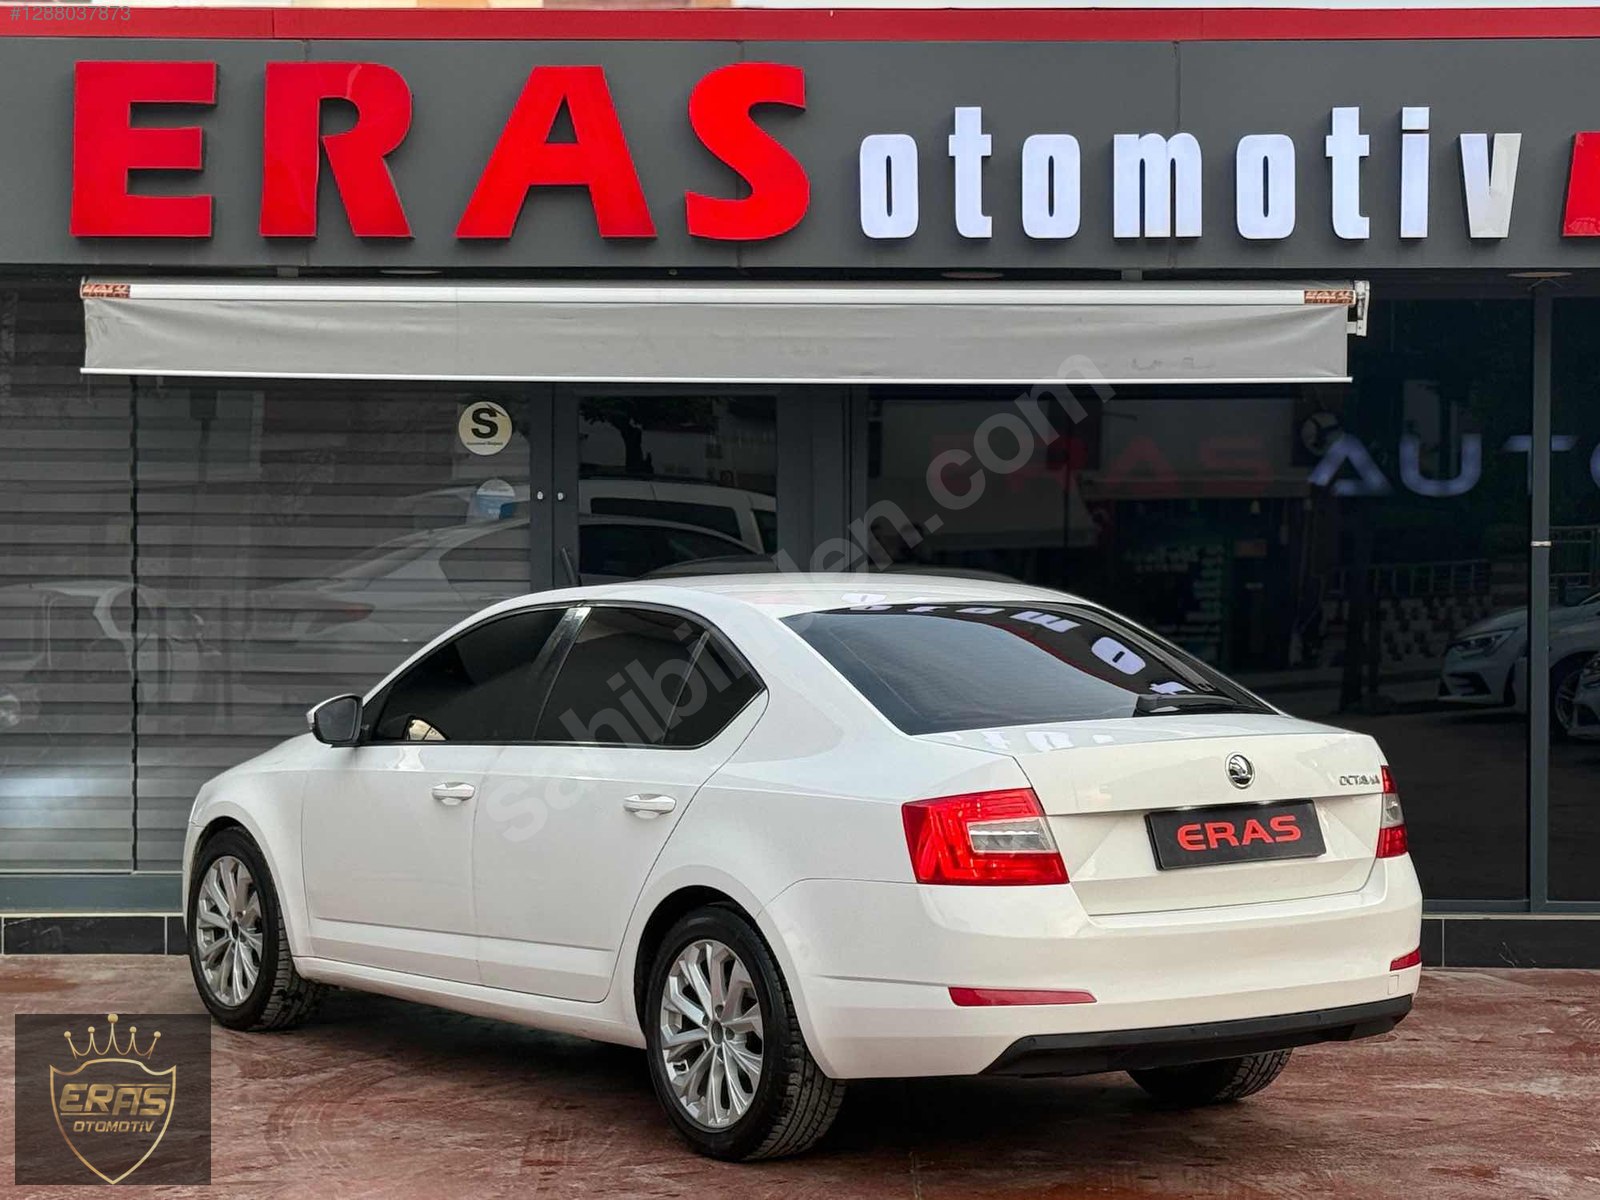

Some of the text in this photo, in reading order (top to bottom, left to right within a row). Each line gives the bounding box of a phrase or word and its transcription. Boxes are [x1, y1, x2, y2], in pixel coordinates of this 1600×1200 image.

[70, 61, 810, 241] ERAS
[859, 106, 1522, 240] otomotiv
[1307, 433, 1600, 497] AUT
[1177, 815, 1302, 851] ERAS
